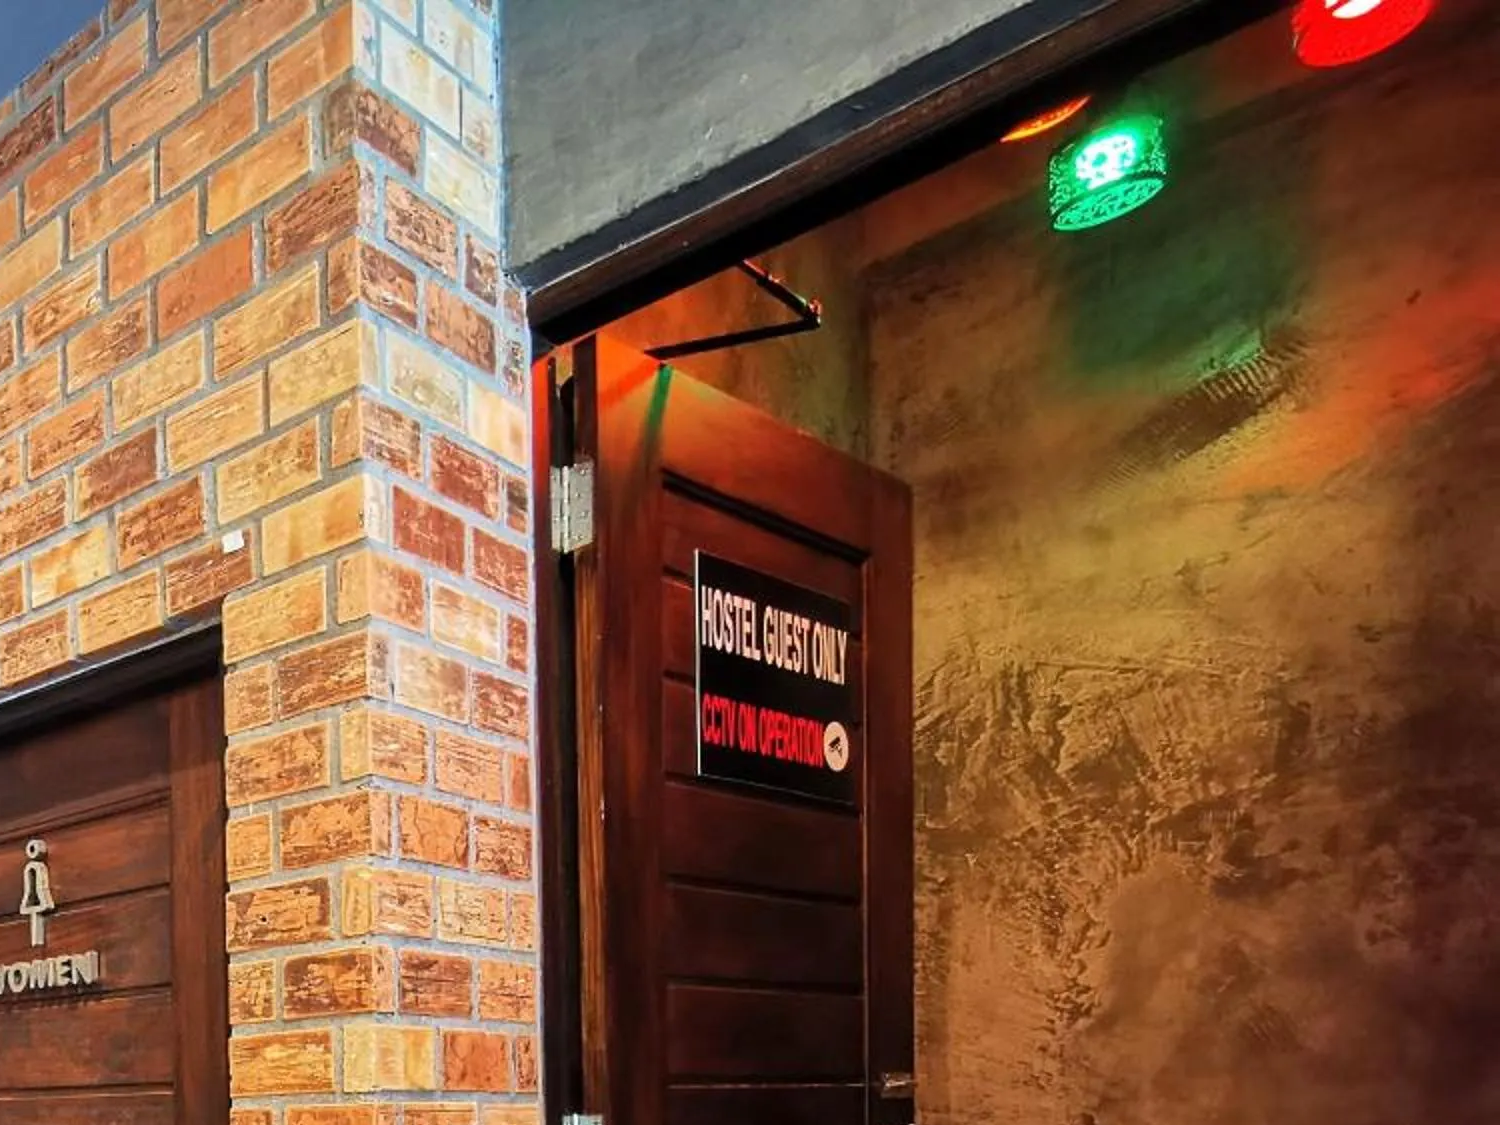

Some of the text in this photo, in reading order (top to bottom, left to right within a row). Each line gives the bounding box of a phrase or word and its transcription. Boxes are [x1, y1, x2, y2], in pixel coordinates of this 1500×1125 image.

[702, 585, 848, 686] HOSTEL GUEST ONLY
[702, 693, 824, 768] CCTV ON OPERATION
